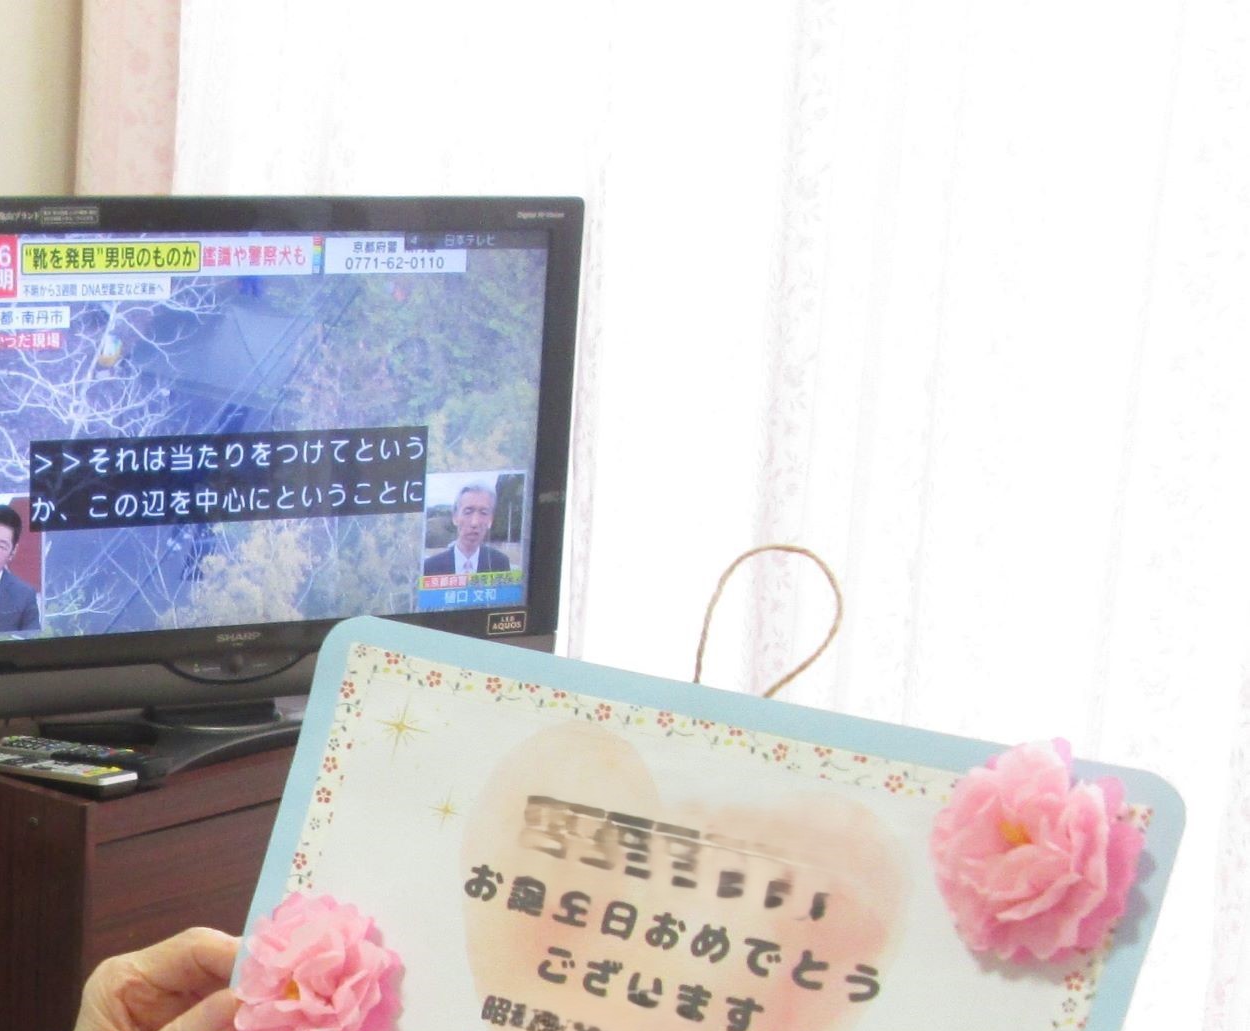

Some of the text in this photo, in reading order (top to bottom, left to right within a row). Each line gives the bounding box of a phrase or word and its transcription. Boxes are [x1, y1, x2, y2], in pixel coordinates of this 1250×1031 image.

[444, 234, 496, 247] 日本テレビ
[344, 256, 445, 271] 0771-62-0110
[31, 480, 424, 522] か、この辺を中心にということに
[492, 621, 522, 630] AQUOS
